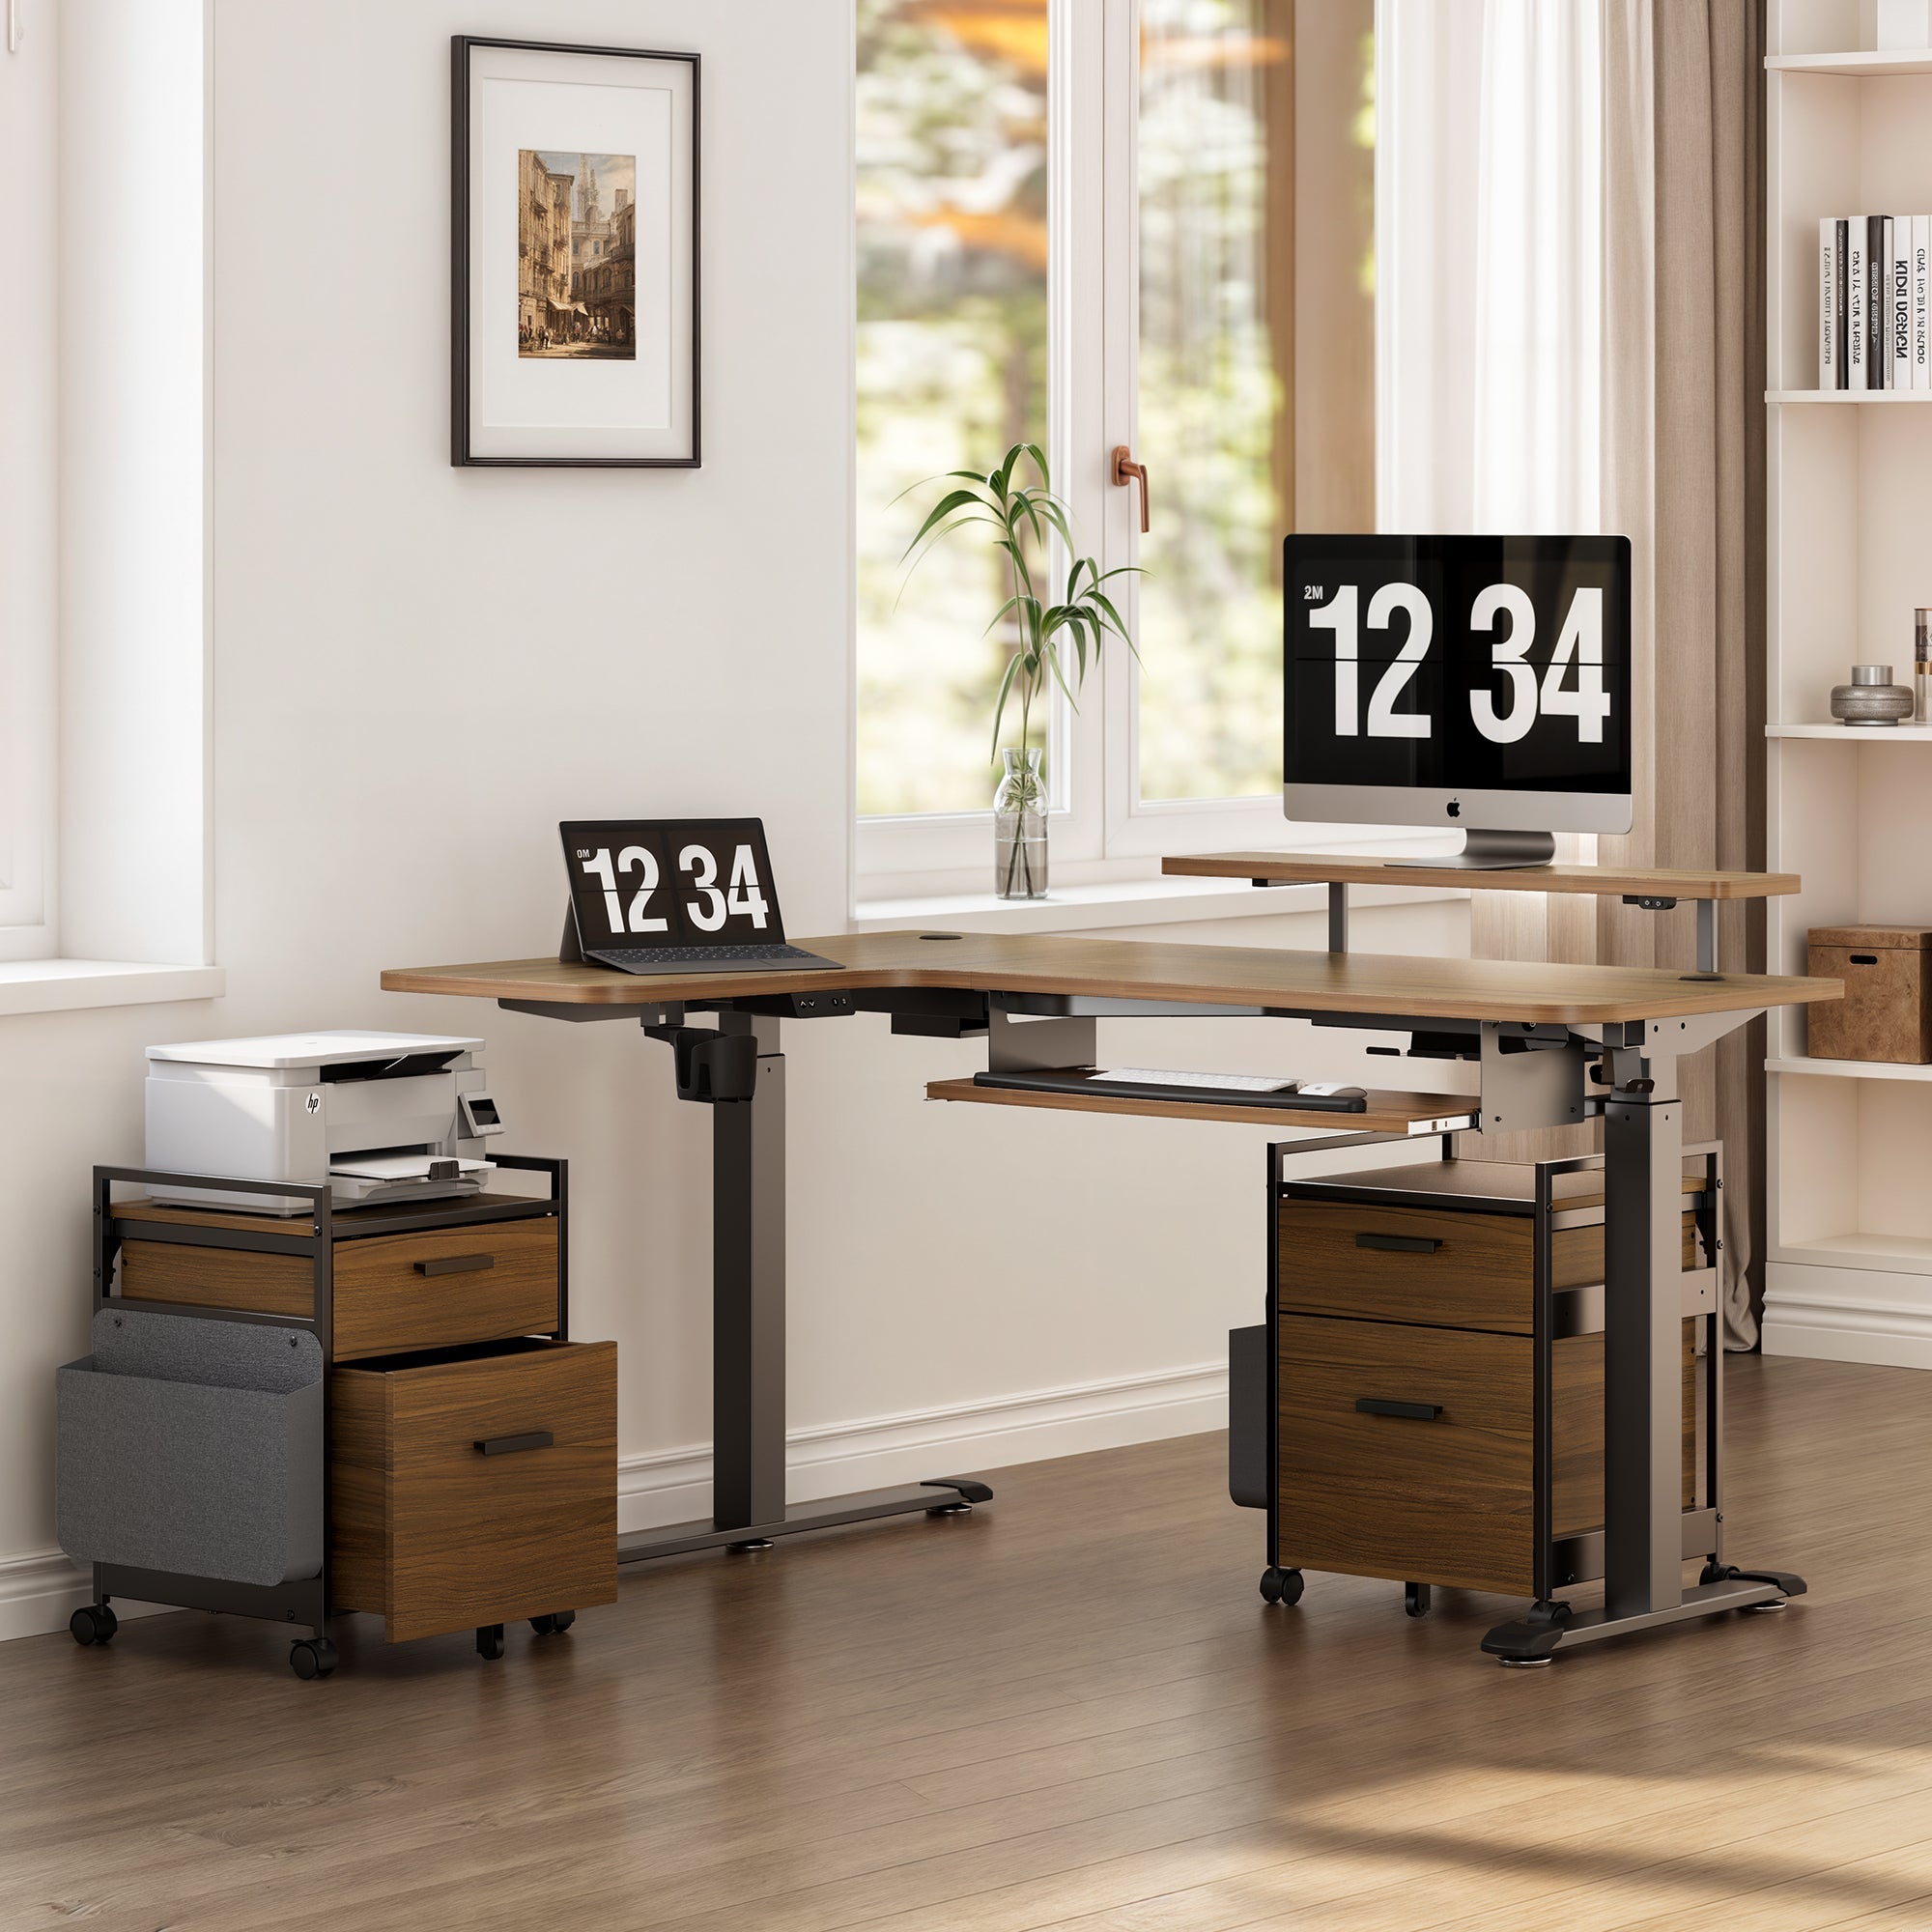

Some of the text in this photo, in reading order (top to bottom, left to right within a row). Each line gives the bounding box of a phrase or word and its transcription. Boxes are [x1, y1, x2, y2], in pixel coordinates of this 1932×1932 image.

[1304, 585, 1323, 600] 2M
[1309, 582, 1611, 744] 12 34
[582, 844, 771, 934] 12 34
[307, 1093, 319, 1114] hp
